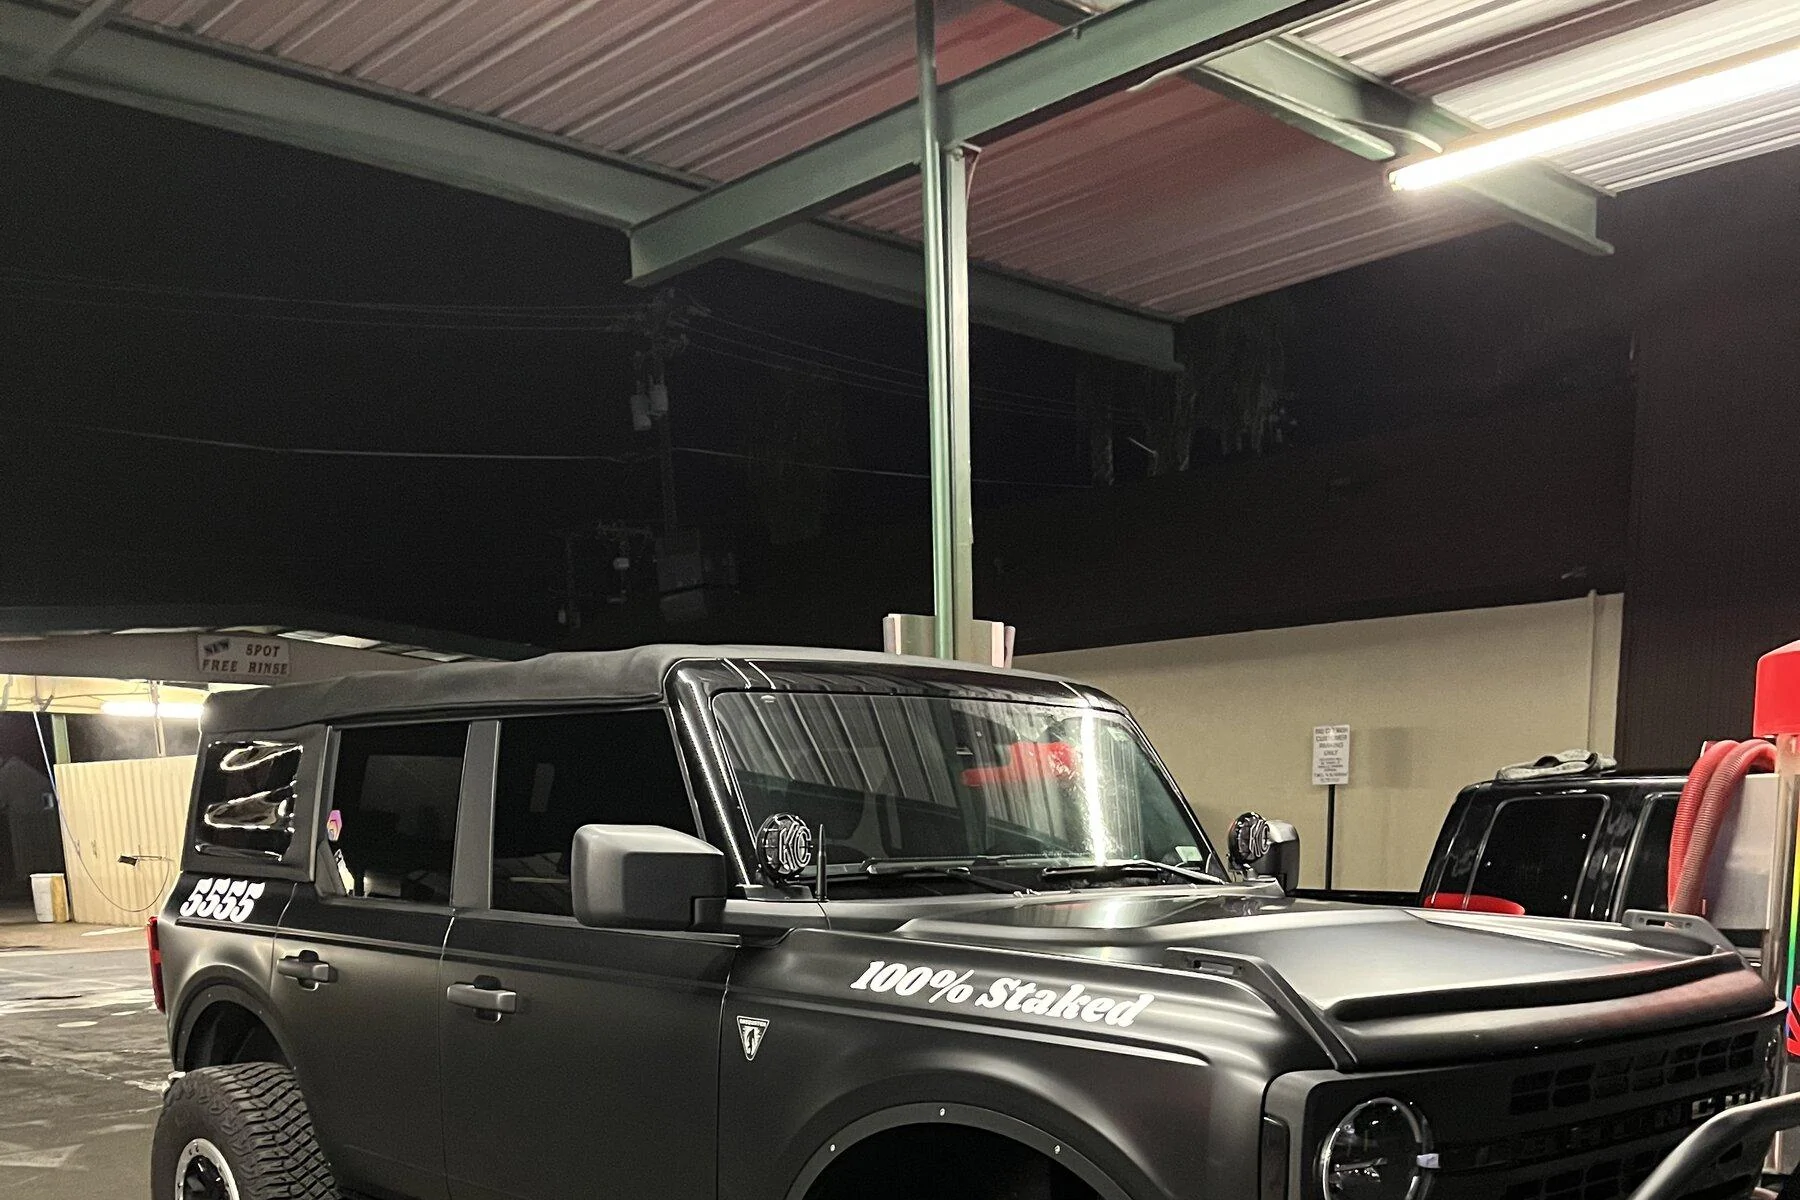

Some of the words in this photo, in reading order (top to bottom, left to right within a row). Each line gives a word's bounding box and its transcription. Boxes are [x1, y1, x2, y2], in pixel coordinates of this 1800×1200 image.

[202, 659, 238, 673] FREE
[247, 661, 288, 675] RINSE
[245, 643, 280, 657] SPOT
[779, 821, 812, 871] KC
[179, 877, 266, 923] 5555
[849, 960, 975, 1004] 100%
[975, 977, 1155, 1028] Staked
